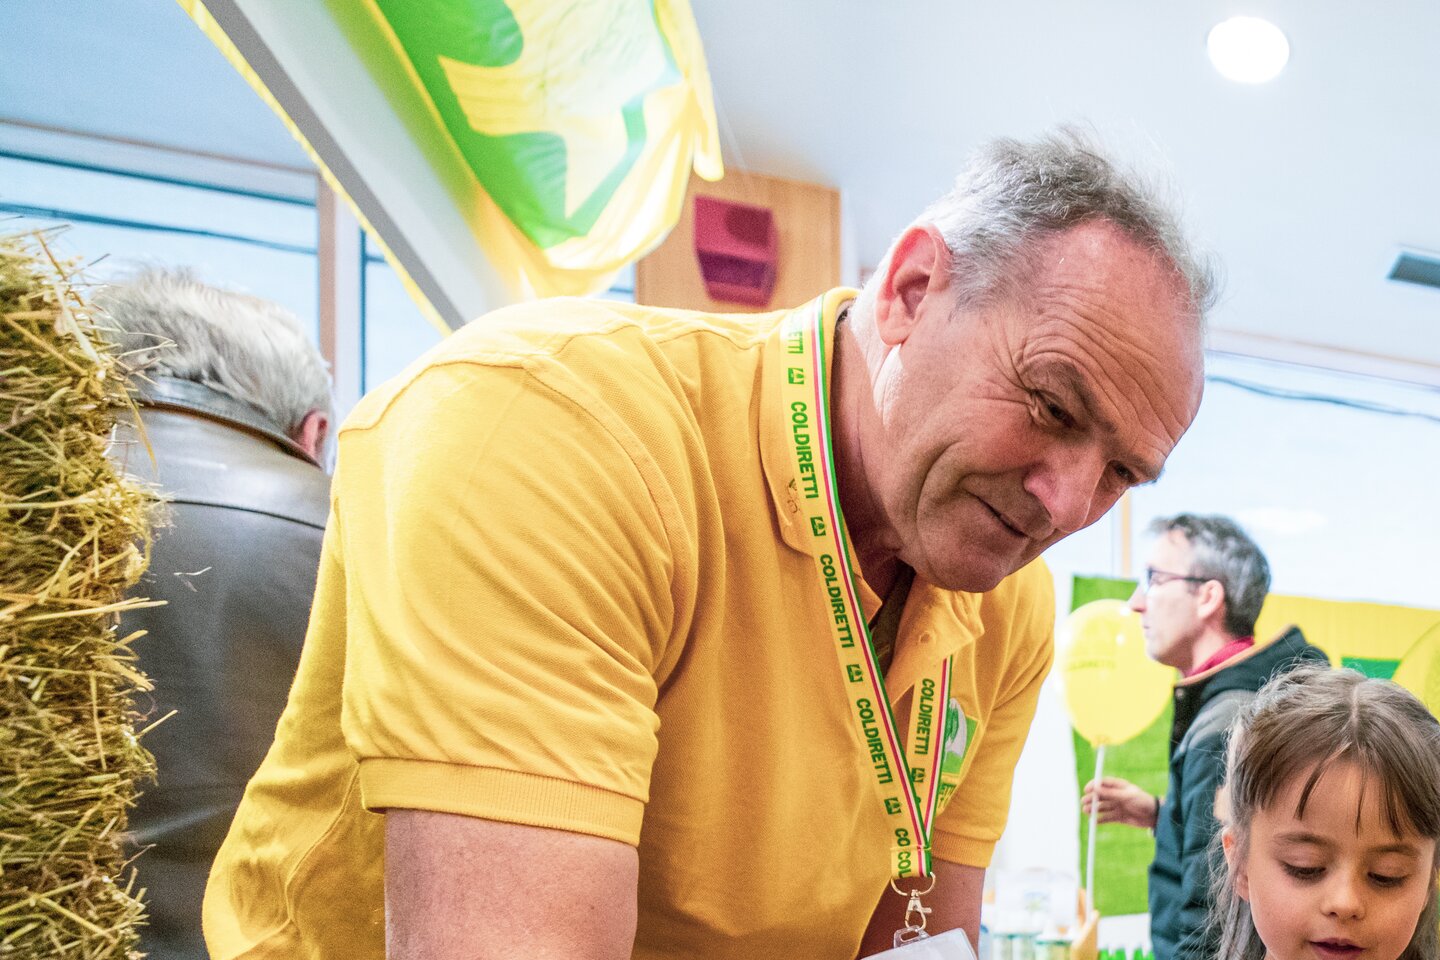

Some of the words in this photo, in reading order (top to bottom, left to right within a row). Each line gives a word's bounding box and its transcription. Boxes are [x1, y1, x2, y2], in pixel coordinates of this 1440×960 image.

[790, 401, 819, 499] COLDIRETTI
[820, 553, 855, 648] COLDIRETTI
[856, 698, 893, 784] COLDIRETTI
[914, 678, 935, 755] COLDIRETTI
[895, 827, 911, 847] CO
